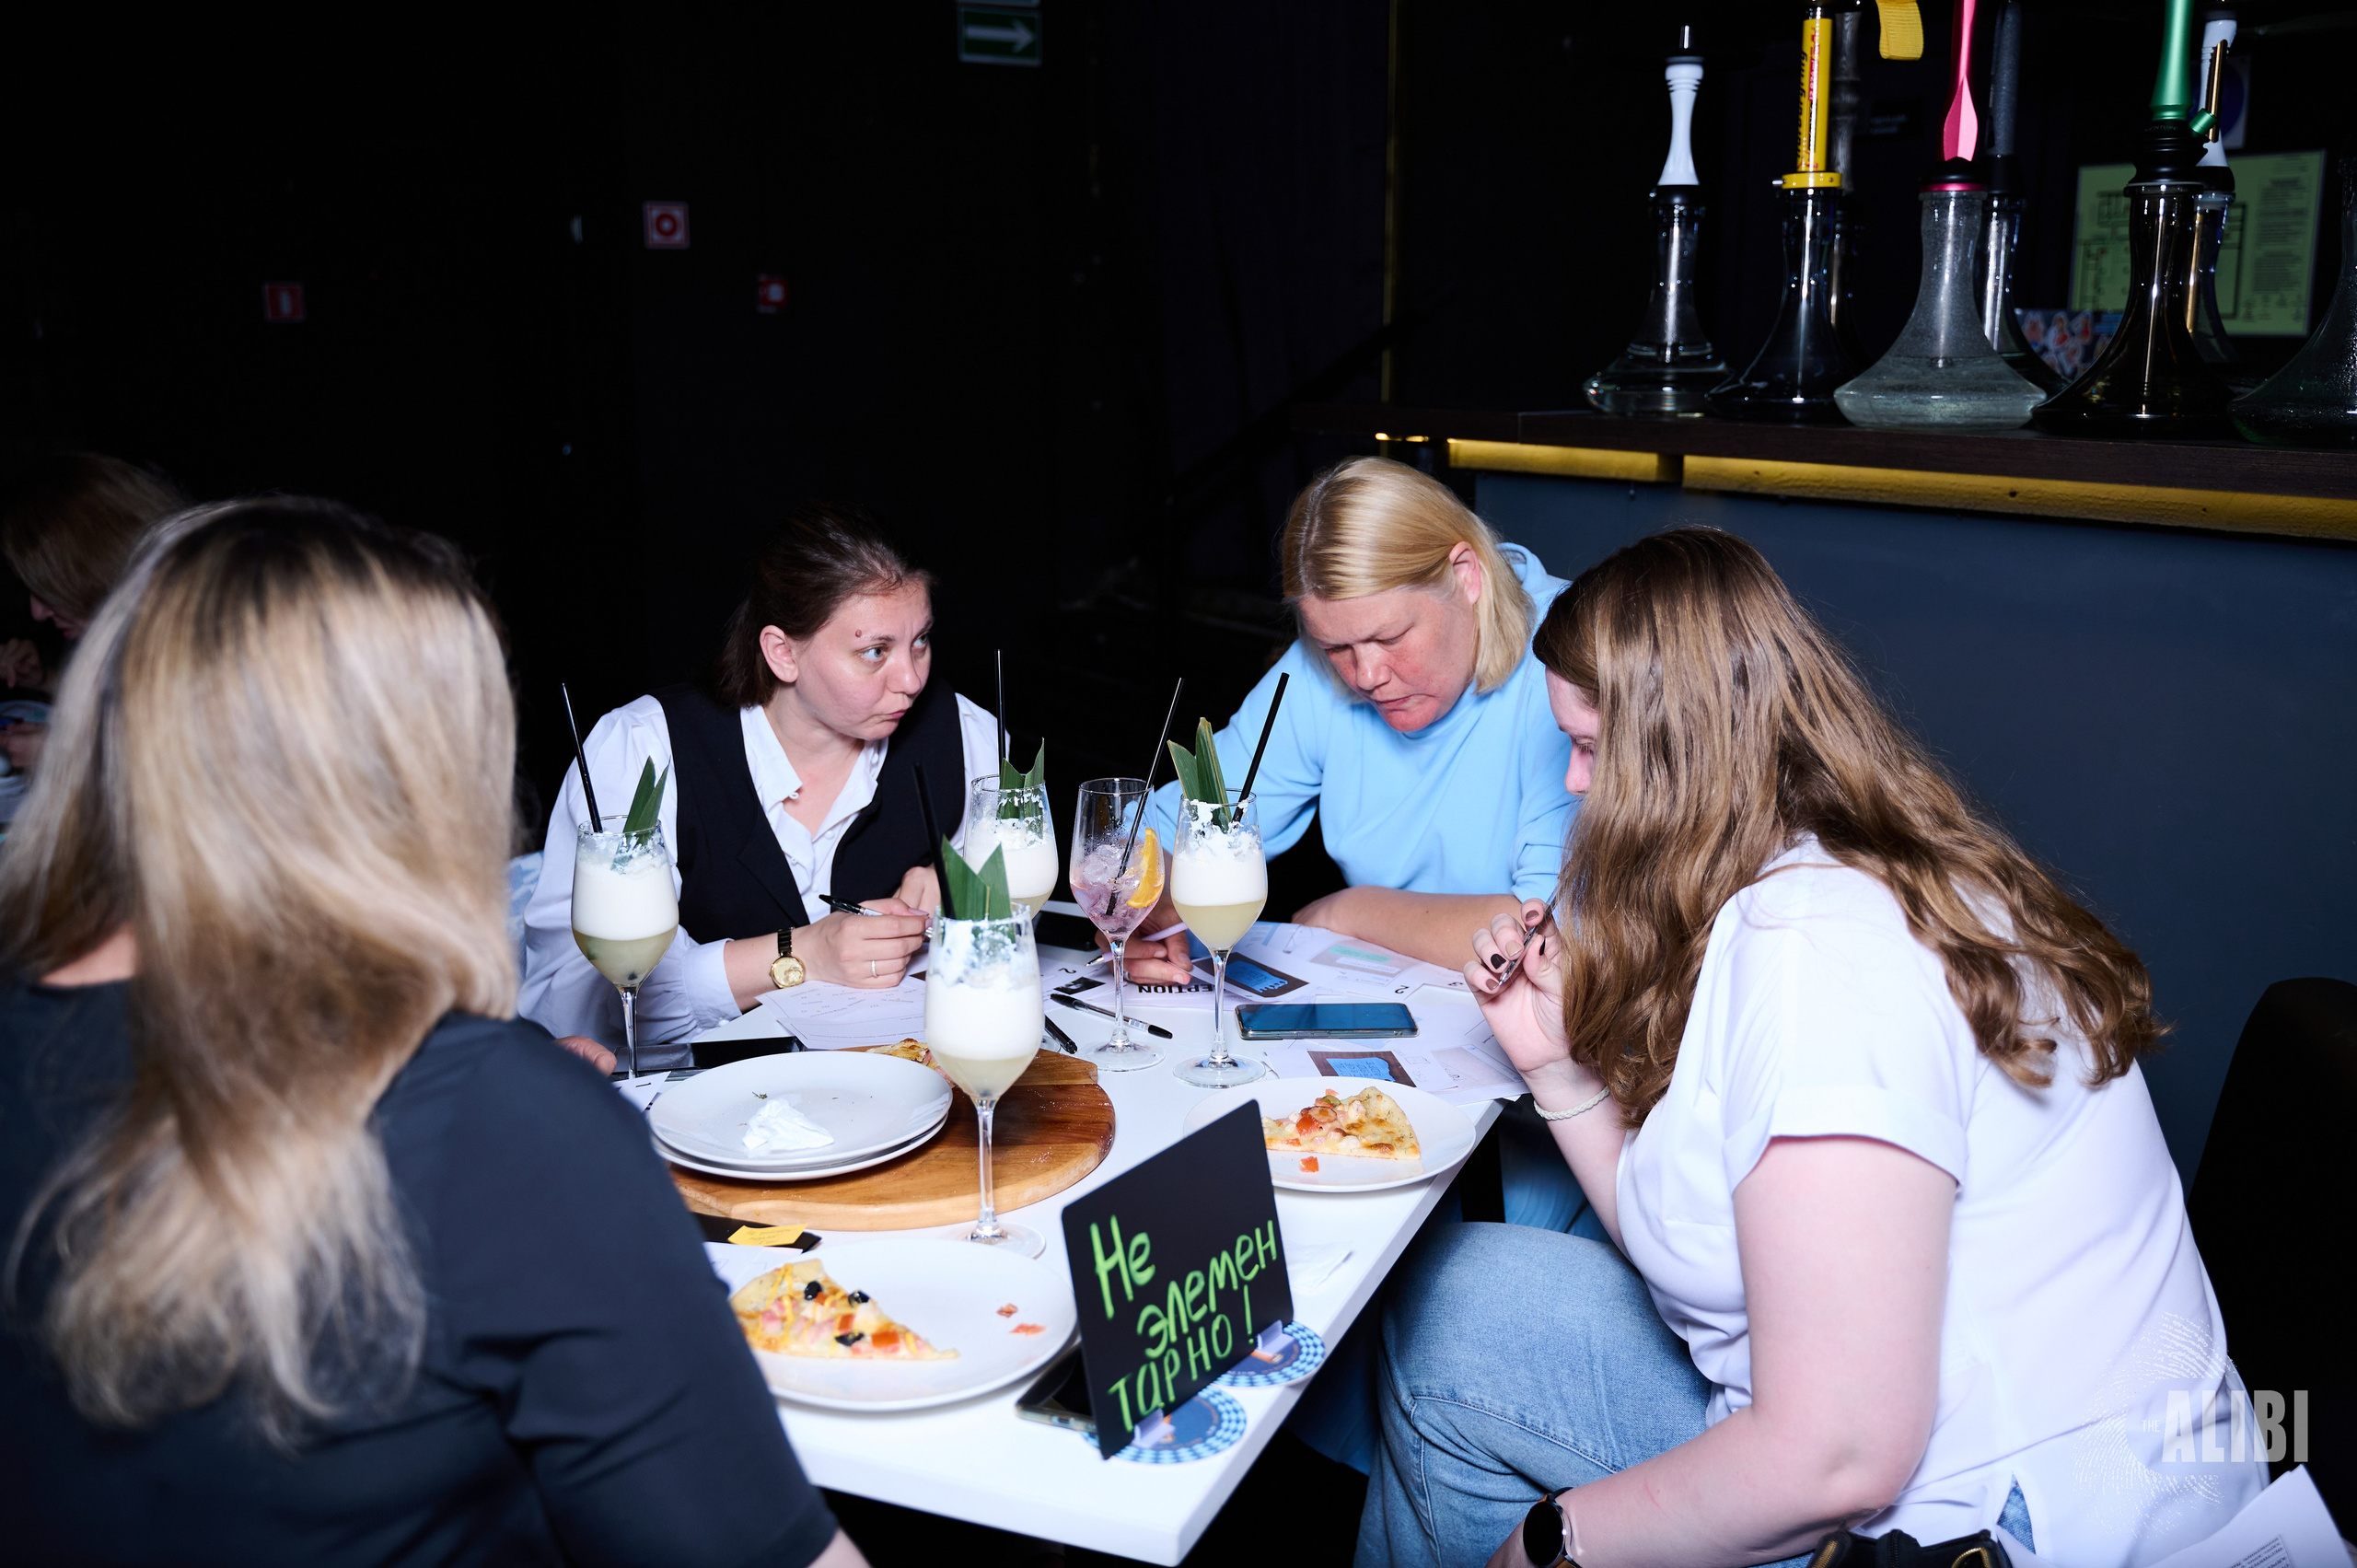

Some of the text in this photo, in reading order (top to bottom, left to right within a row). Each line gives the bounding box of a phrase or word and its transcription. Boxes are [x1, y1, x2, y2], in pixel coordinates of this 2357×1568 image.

[1138, 983, 1214, 993] EPTION
[1394, 984, 1410, 994] 2
[1090, 1214, 1155, 1320] Не
